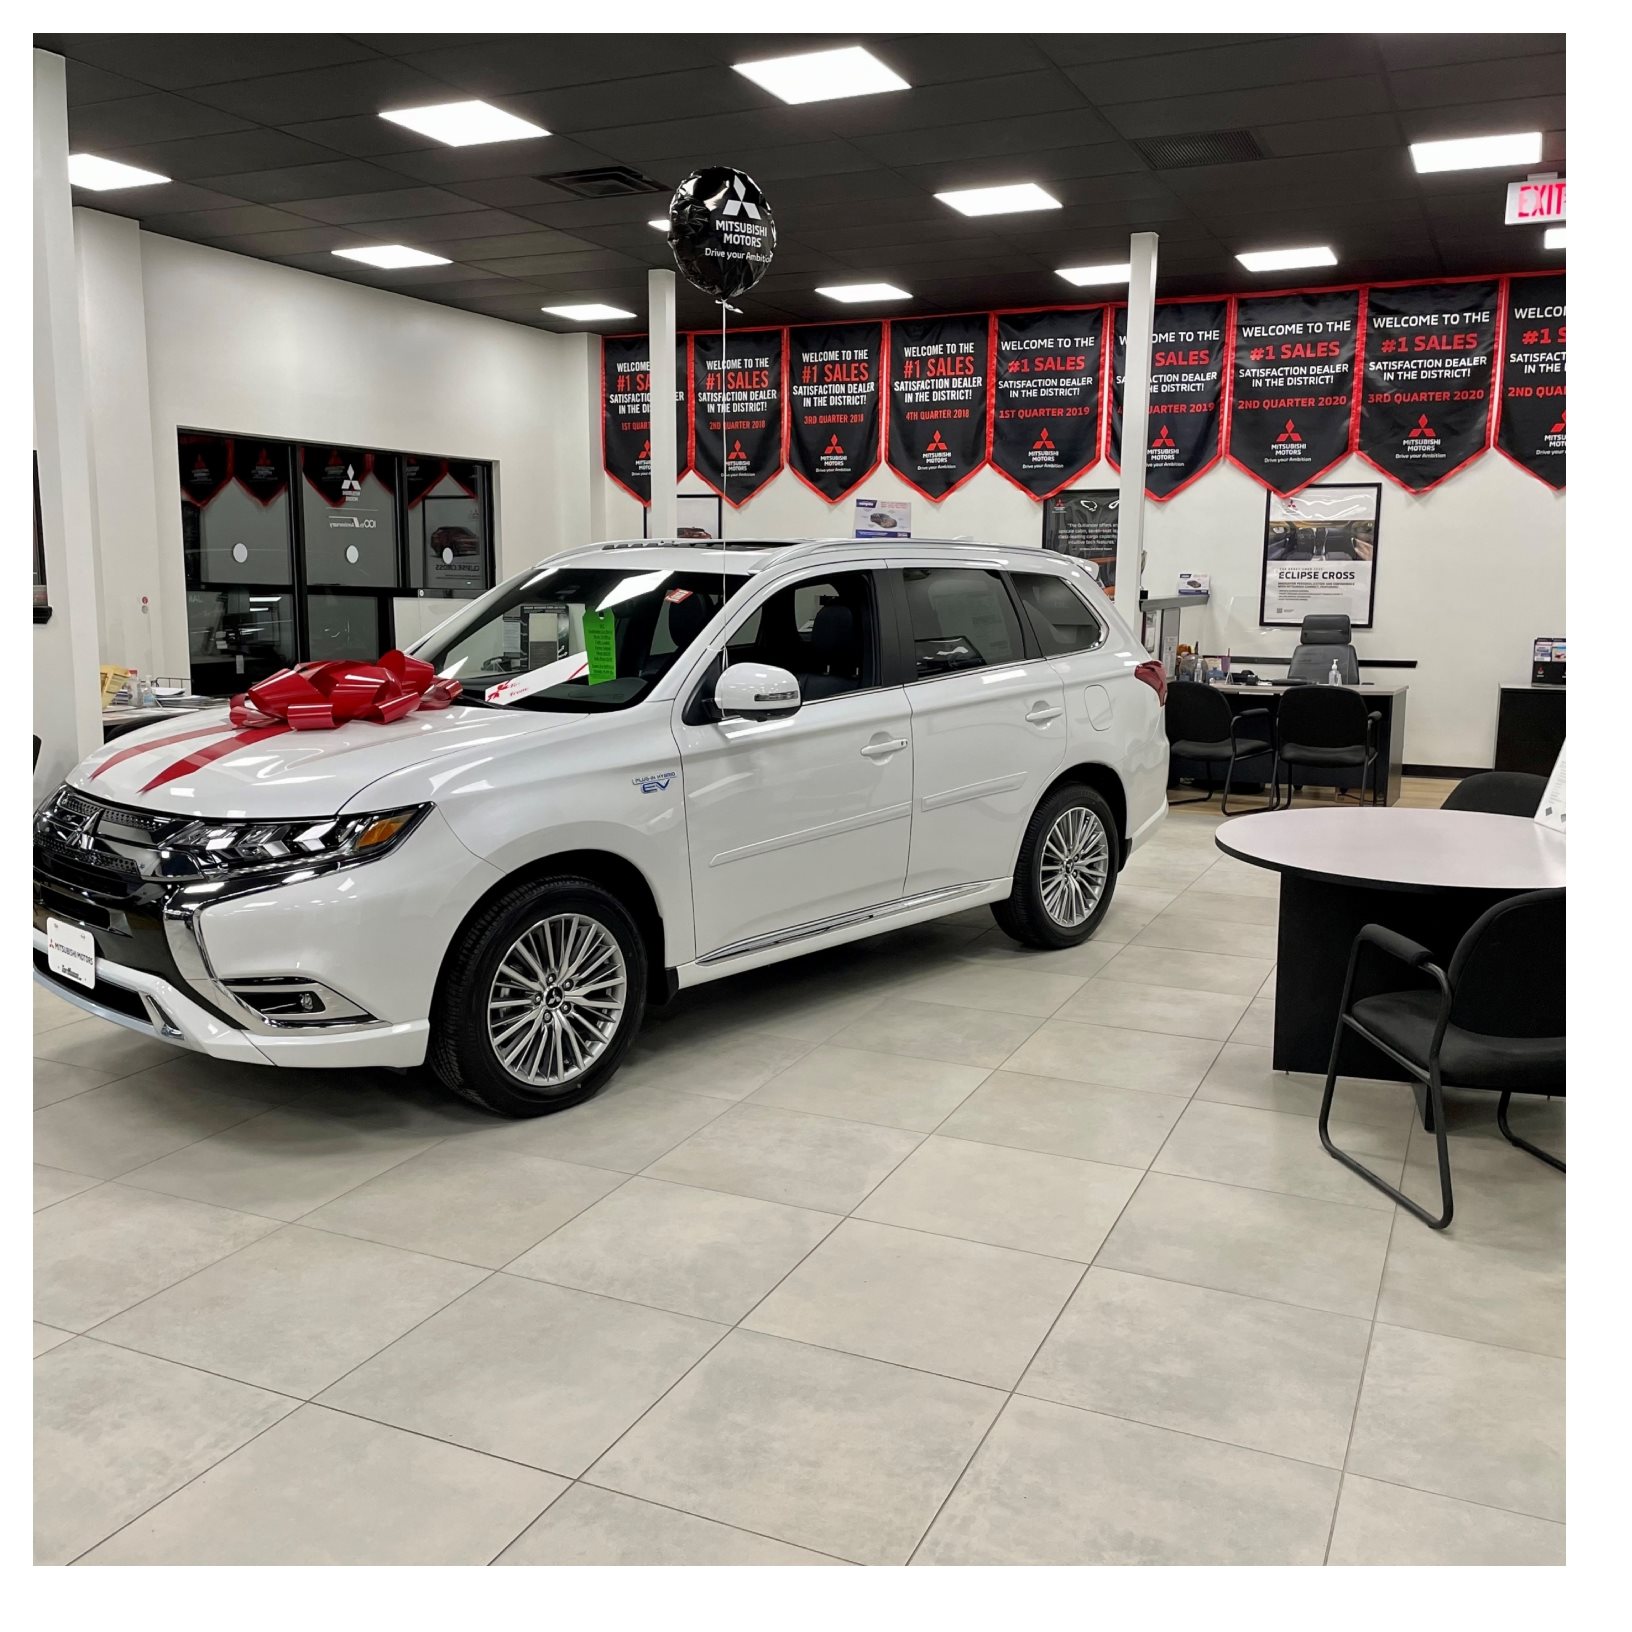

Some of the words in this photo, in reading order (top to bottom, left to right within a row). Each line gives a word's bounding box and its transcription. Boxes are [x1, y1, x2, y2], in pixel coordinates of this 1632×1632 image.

[1518, 183, 1566, 218] EXIT
[715, 220, 768, 237] MITSUBISHI
[723, 233, 762, 248] MOTORS
[704, 248, 725, 257] Drive
[726, 251, 745, 260] your
[745, 252, 773, 263] Ambitio
[1373, 314, 1438, 329] WELCOME
[1442, 313, 1460, 325] TO
[1463, 311, 1490, 324] THE
[1242, 324, 1303, 338] WELCOME
[1306, 322, 1323, 334] TO
[1326, 320, 1351, 332] THE
[1381, 337, 1409, 353] #1
[1414, 333, 1478, 352] SALES
[1249, 345, 1275, 361] #1
[1280, 342, 1340, 360] SALES
[1239, 366, 1307, 378] SATISFACTION
[1309, 363, 1349, 375] DEALER
[1368, 359, 1443, 371] SATISFACTION
[1445, 356, 1487, 368] DEALER
[1252, 378, 1263, 387] IN
[1264, 377, 1285, 387] THE
[1286, 374, 1334, 386] DISTRICT!
[1383, 371, 1395, 381] IN
[1397, 370, 1418, 380] THE
[1420, 368, 1471, 379] DISTRICT!
[1238, 400, 1259, 410] 2ND
[1262, 398, 1315, 410] QUARTER
[1317, 395, 1347, 406] 2020
[1368, 393, 1390, 404] 3RD
[1394, 391, 1450, 404] QUARTER
[1453, 389, 1484, 400] 2020
[998, 409, 1016, 418] 1ST
[1018, 408, 1064, 418] QUARTER
[1066, 406, 1090, 416] 2019
[1403, 438, 1441, 446] MITSUBISHI
[1279, 571, 1319, 579] ECLIPSE
[1322, 571, 1355, 580] CROSS
